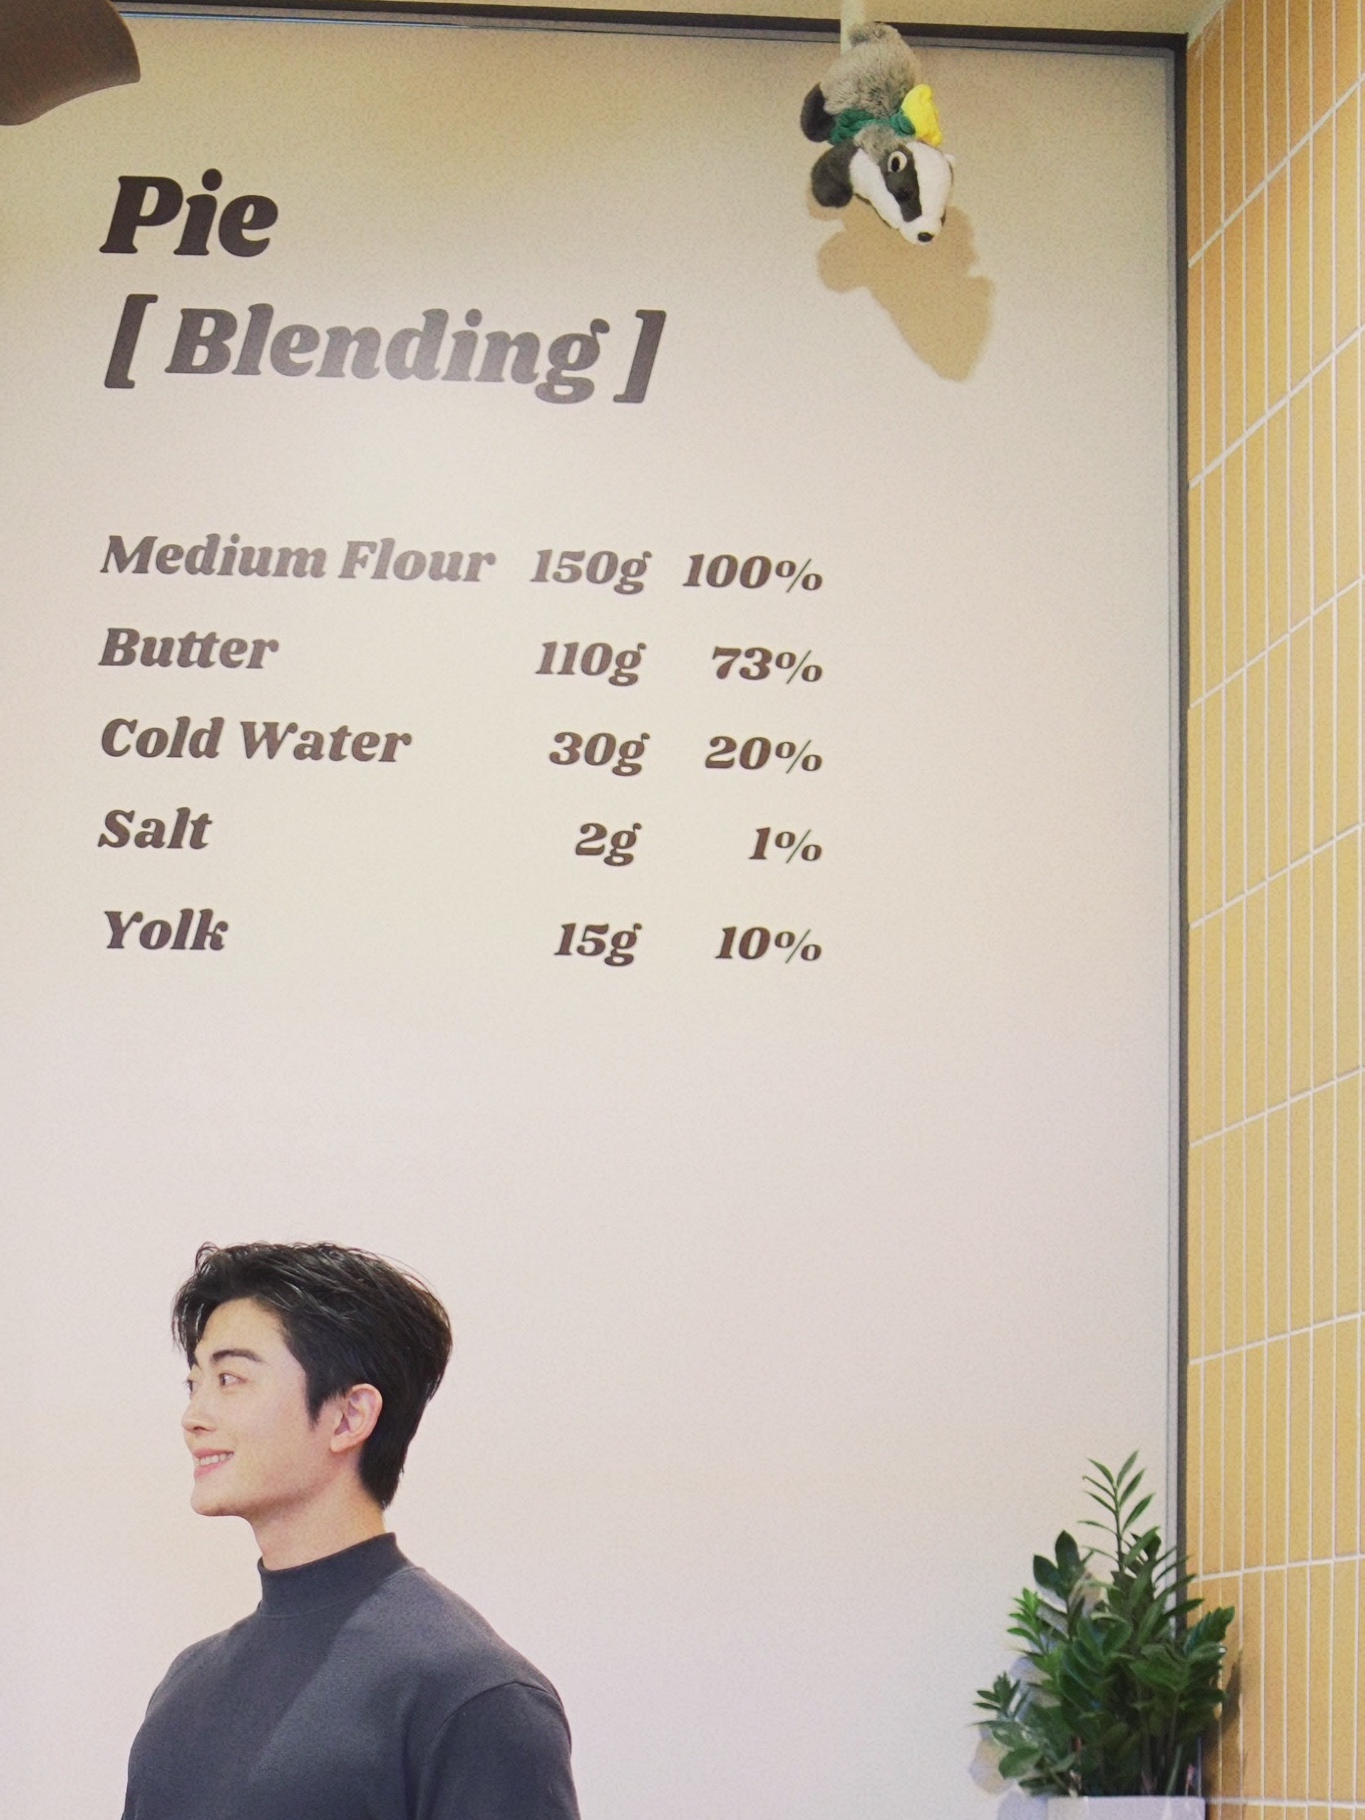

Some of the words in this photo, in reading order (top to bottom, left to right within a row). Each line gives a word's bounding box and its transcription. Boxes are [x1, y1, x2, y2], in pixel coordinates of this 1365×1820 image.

[99, 168, 278, 257] Pie
[164, 303, 610, 404] Blending
[100, 533, 326, 578] Medium
[338, 538, 496, 582] Flour
[530, 549, 652, 595] 150g
[683, 554, 822, 592] 100%
[98, 628, 279, 669] Butter
[535, 642, 646, 687] 110g
[712, 646, 822, 684] 73%
[101, 716, 224, 758] Cold
[240, 721, 412, 762] Water
[549, 732, 650, 777] 30g
[705, 736, 822, 773] 20%
[97, 807, 212, 850] Salt
[575, 823, 642, 867] 2g
[749, 827, 822, 863] 1%
[104, 908, 228, 951] Yolk
[554, 923, 642, 967] 15g
[715, 927, 821, 963] 10%
